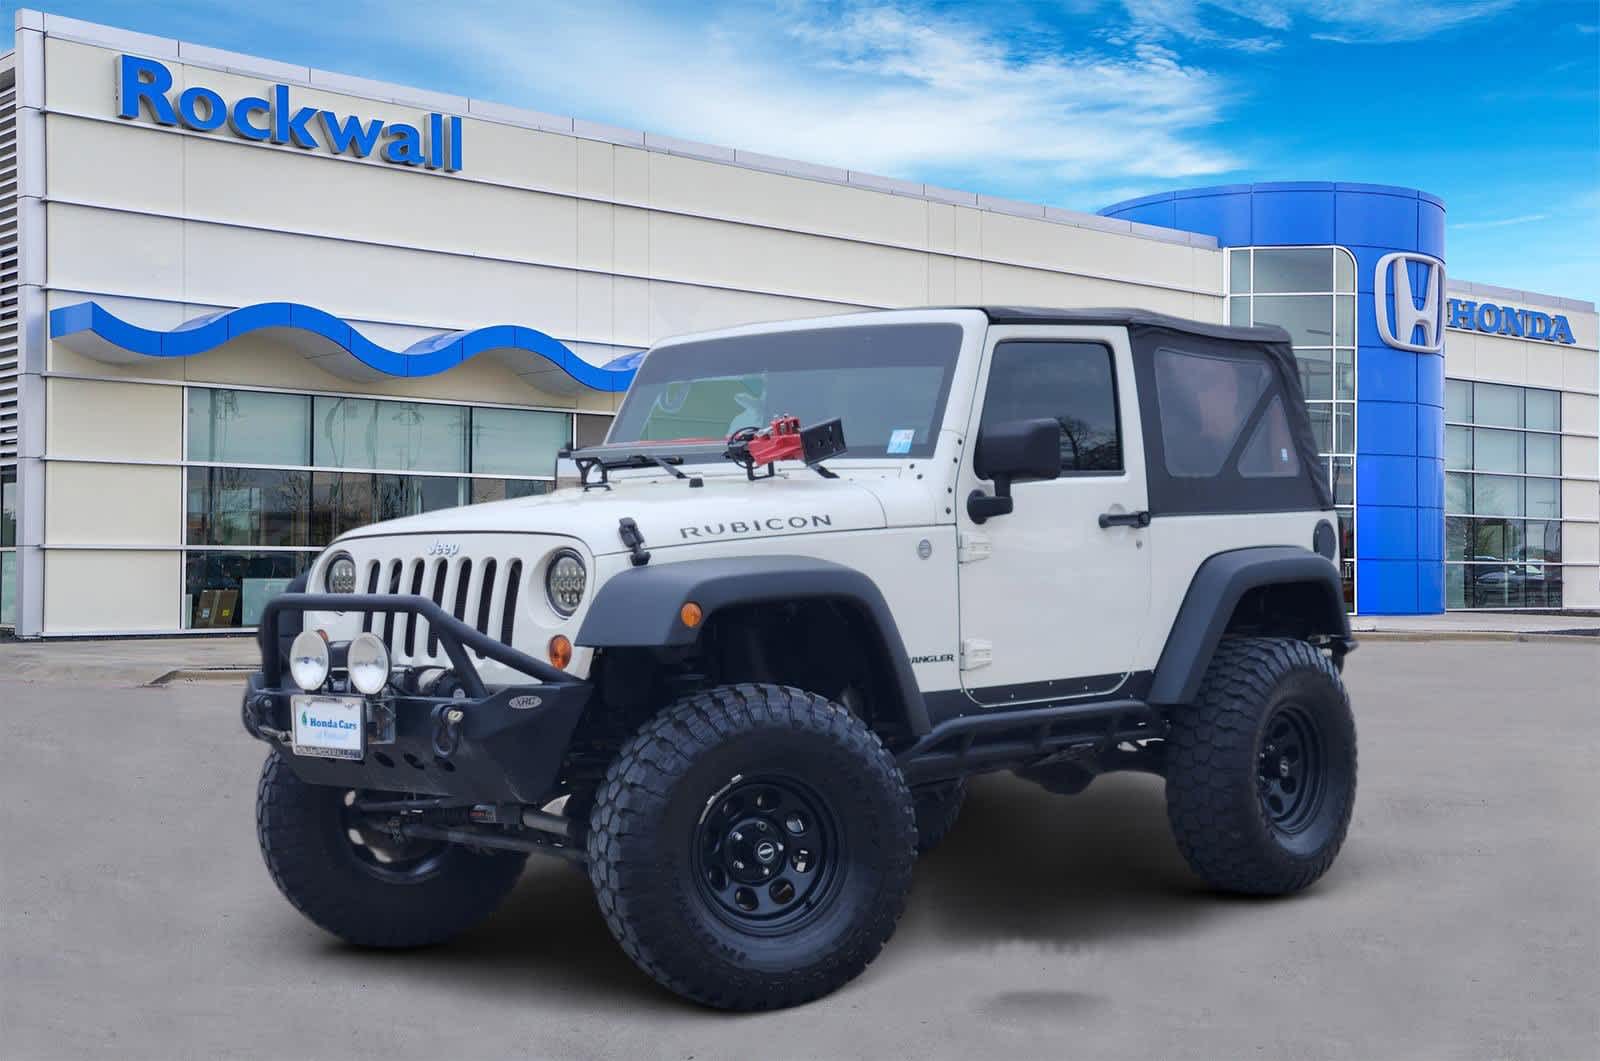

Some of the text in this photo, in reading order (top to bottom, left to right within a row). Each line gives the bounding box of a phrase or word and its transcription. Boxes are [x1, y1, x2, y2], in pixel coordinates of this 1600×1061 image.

[117, 54, 463, 172] Rockwall
[1447, 299, 1576, 344] HONDA
[680, 514, 832, 539] RUBICON
[427, 538, 460, 558] Jeep
[910, 654, 954, 664] ANGLER
[310, 717, 358, 730] Honda Cars
